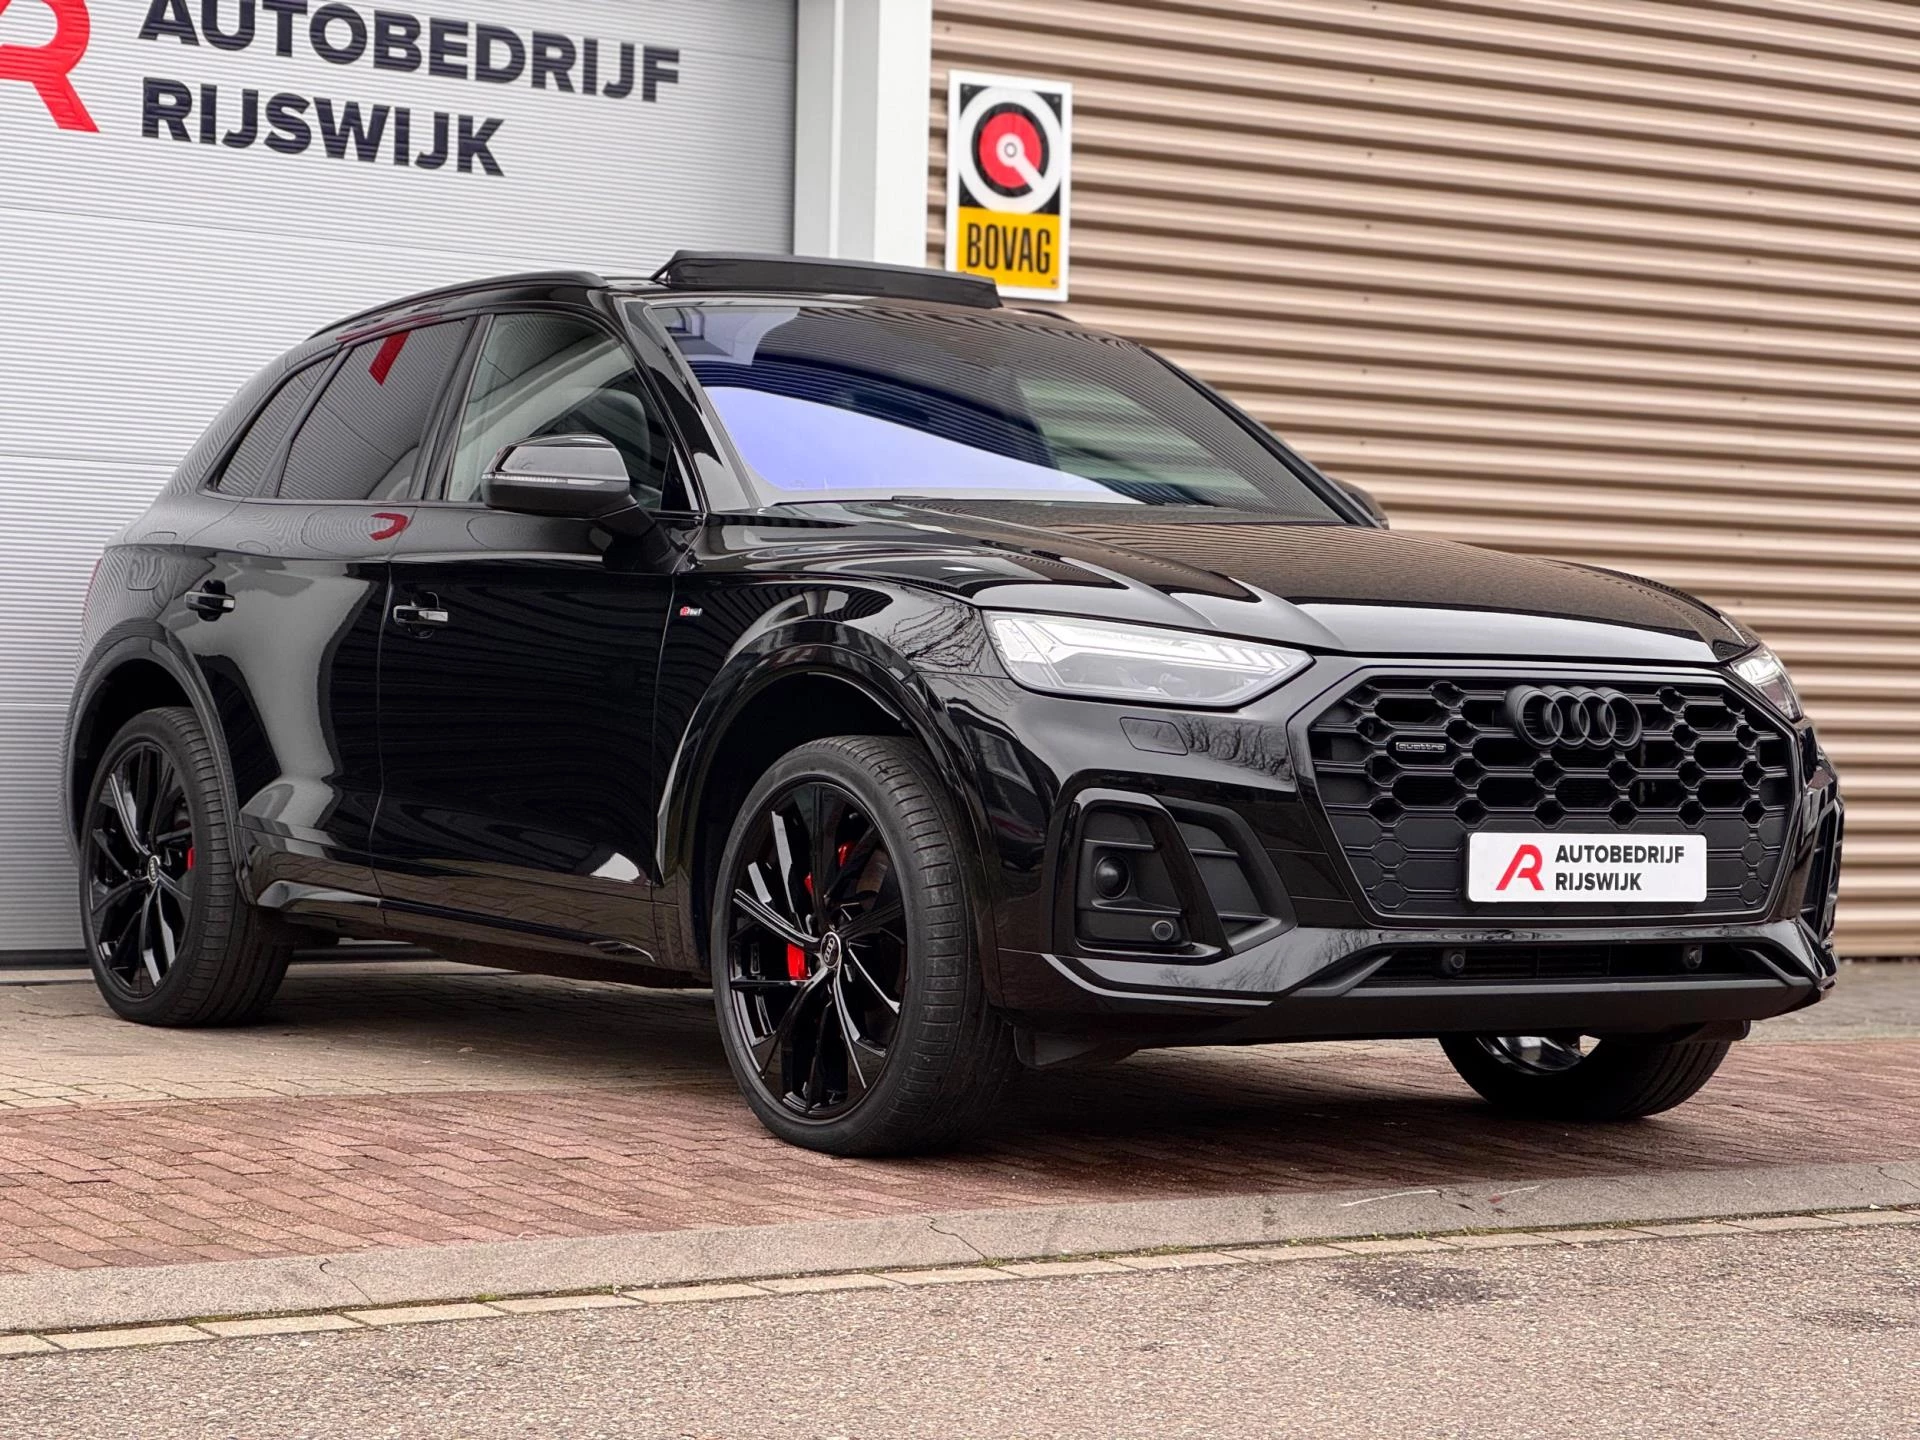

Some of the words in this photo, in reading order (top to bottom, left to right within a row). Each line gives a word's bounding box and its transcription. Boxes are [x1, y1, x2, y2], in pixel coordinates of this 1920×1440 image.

[138, 0, 680, 103] AUTOBEDRIJF
[142, 77, 504, 177] RIJSWIJK
[966, 222, 1050, 275] BOVAG
[1555, 844, 1685, 864] AUTOBEDRIJF
[1555, 872, 1642, 891] RIJSWIJK
